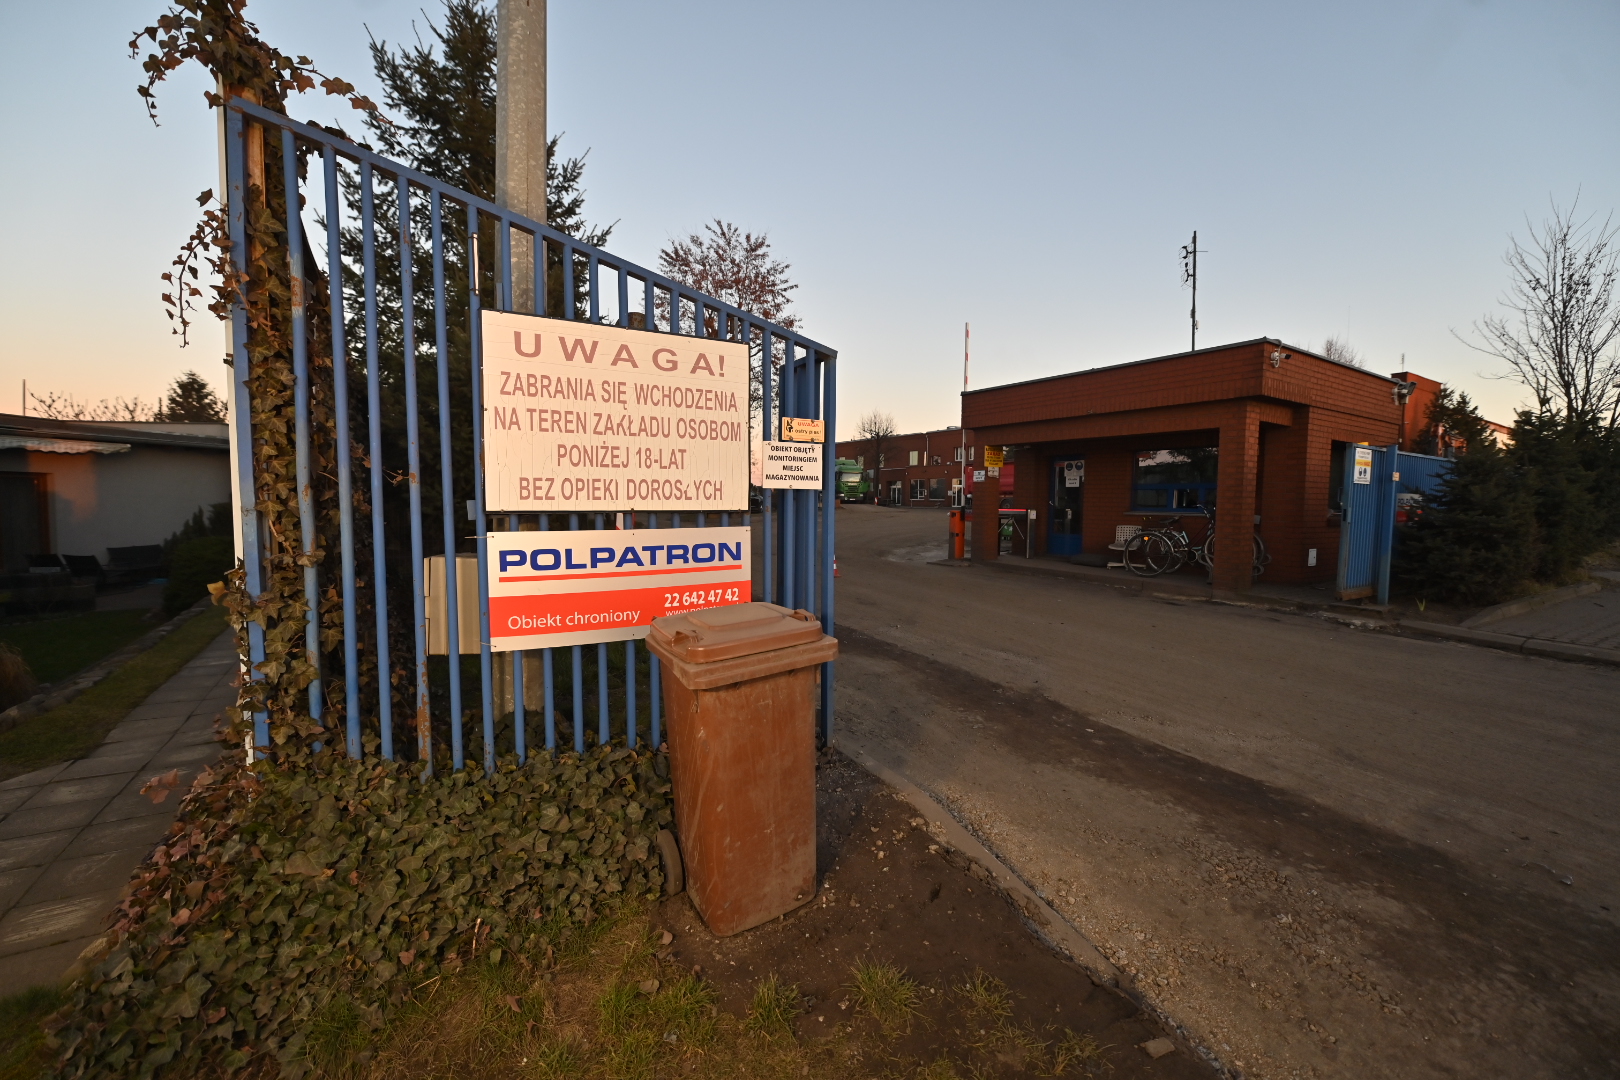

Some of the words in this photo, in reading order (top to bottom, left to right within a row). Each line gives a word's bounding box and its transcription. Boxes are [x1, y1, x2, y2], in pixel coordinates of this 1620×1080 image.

[514, 331, 725, 378] UWAGA!
[500, 371, 596, 401] ZABRANIA
[601, 380, 628, 410] SIĘ
[634, 383, 738, 412] WCHODZENIA
[494, 406, 521, 431] NA
[526, 408, 587, 434] TEREN
[593, 413, 671, 439] ZAKŁADU
[676, 418, 741, 442] OSOBOM
[557, 441, 630, 469] PONIŻEJ
[636, 447, 687, 470] 18-LAT
[768, 455, 817, 463] MONITORINGIEM
[793, 446, 815, 454] OBJĘTY
[519, 477, 555, 501] BEZ
[561, 477, 619, 501] OPIEKI
[626, 478, 723, 501] DOROSŁYCH
[765, 473, 819, 481] MAGAZYNOWANIA
[498, 541, 742, 573] POLPATRON
[664, 592, 680, 608] 22
[682, 590, 706, 606] 642
[707, 589, 723, 603] 47
[724, 587, 739, 602] 42
[507, 611, 562, 630] Obiekt
[565, 608, 641, 627] chroniony
